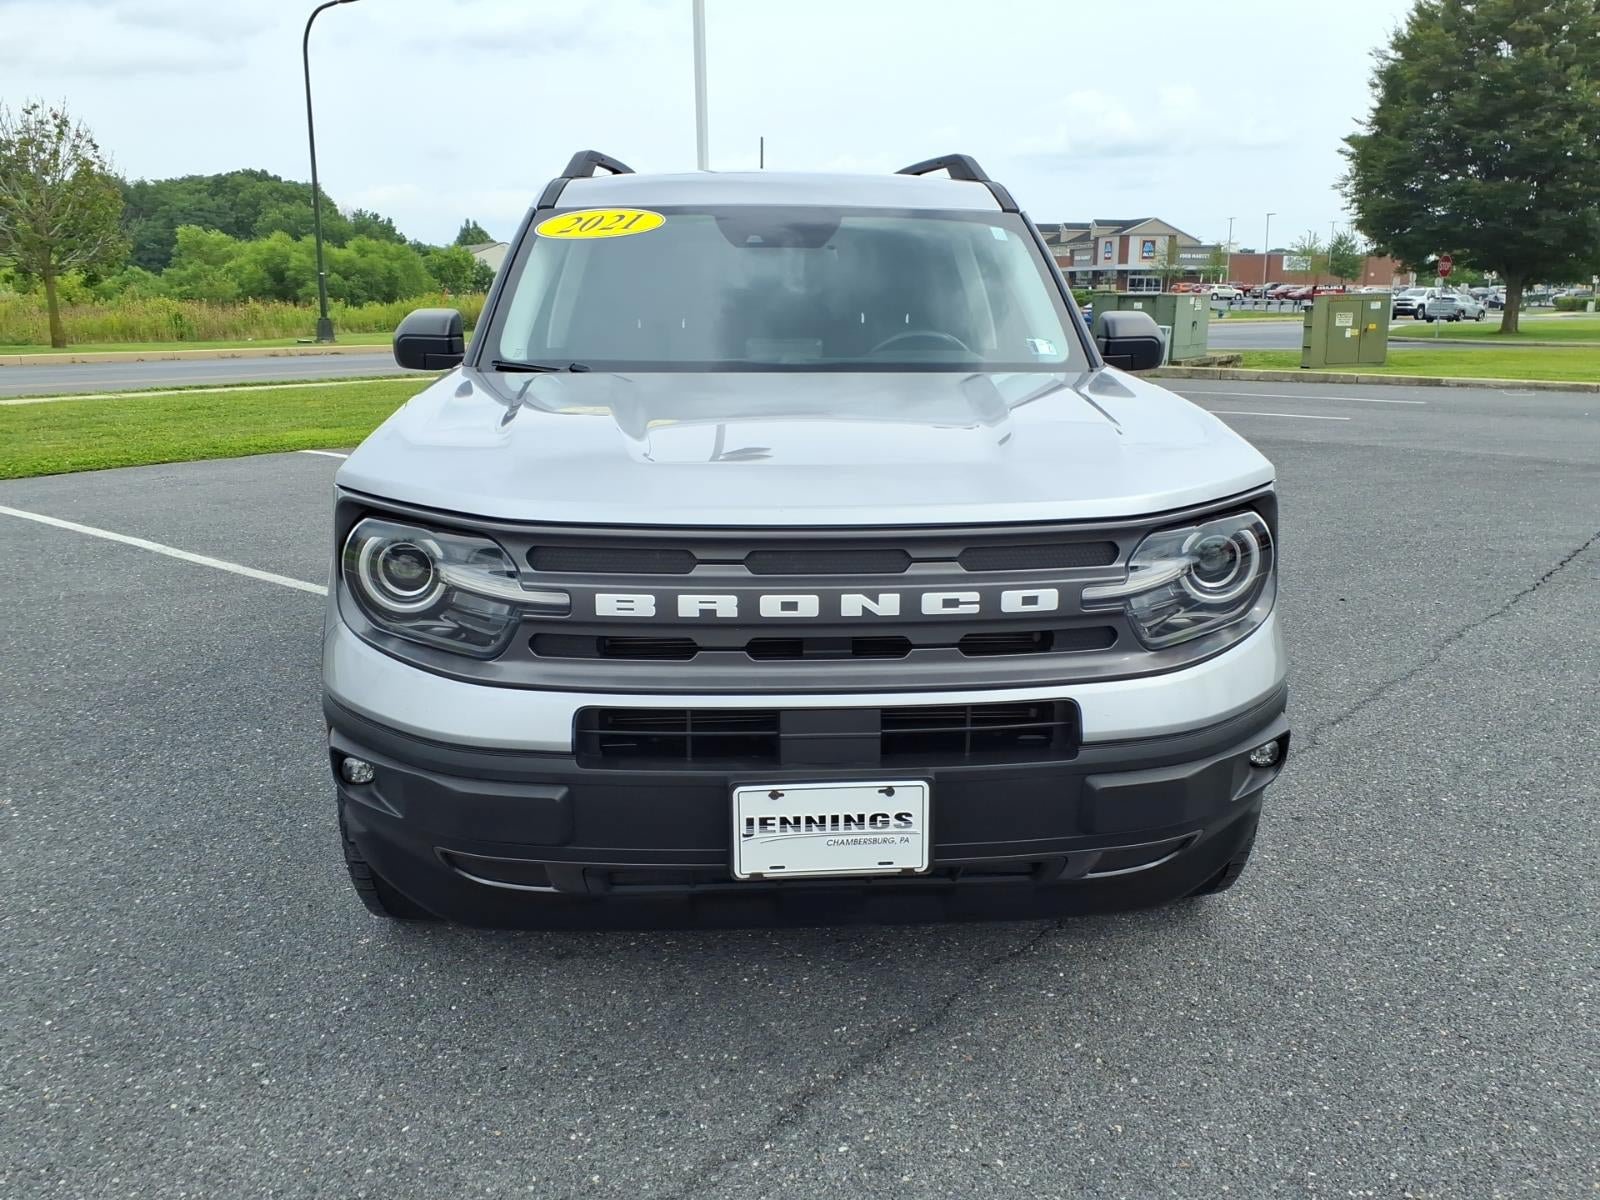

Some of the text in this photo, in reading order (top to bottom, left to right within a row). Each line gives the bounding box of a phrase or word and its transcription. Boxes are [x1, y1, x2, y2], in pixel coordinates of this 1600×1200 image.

[556, 213, 645, 234] 2021
[1439, 261, 1452, 271] STOP
[595, 588, 1059, 617] BRONCO
[742, 812, 913, 838] JENNINGS
[826, 836, 910, 847] CHAMBERSBURG, PA
